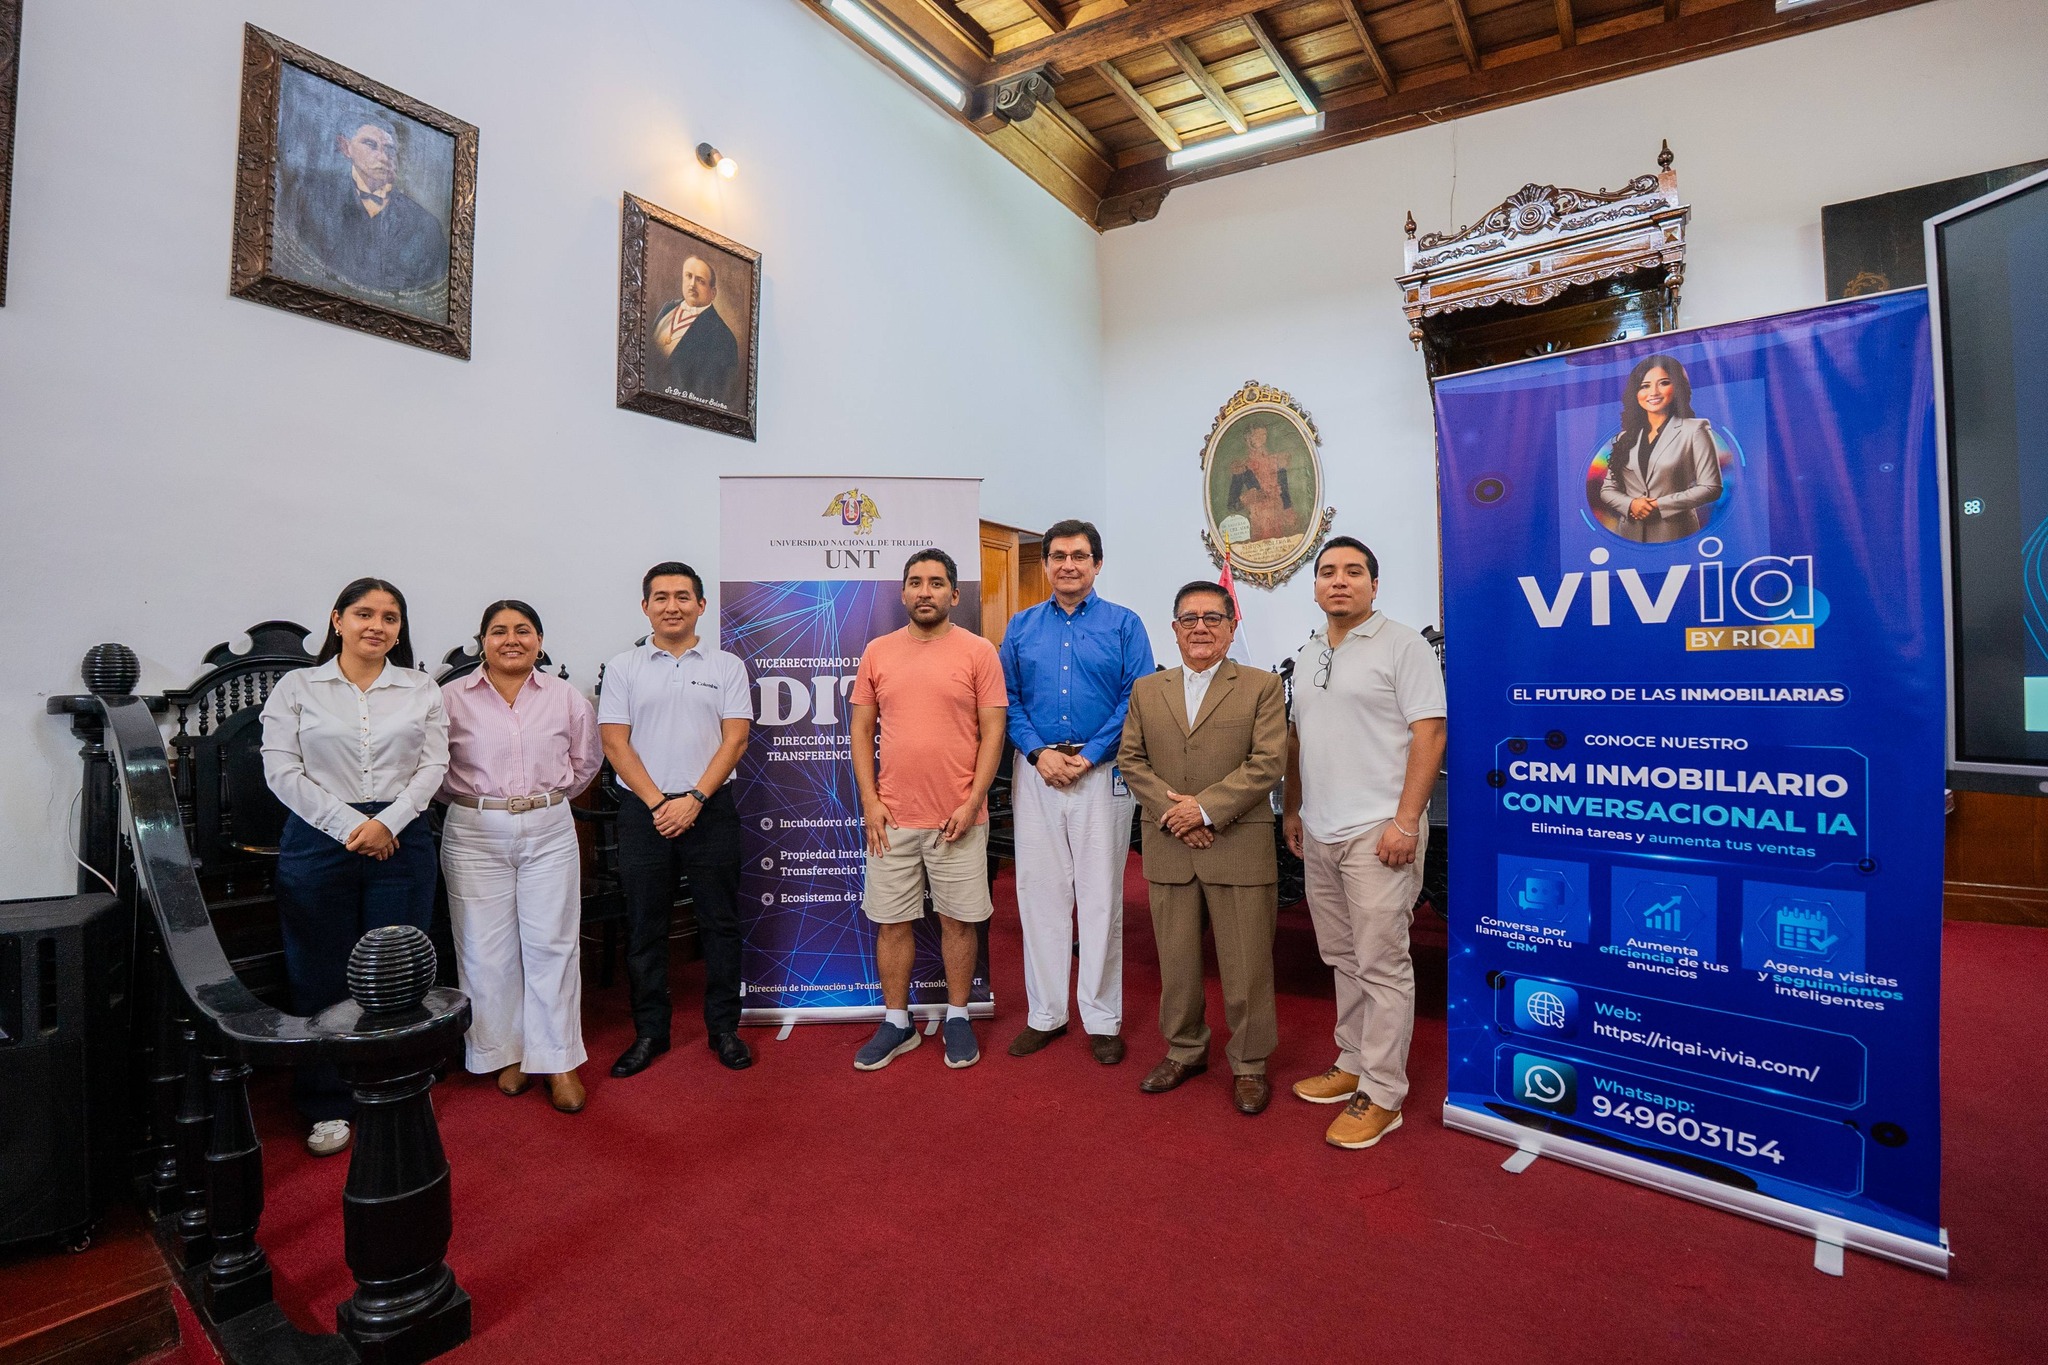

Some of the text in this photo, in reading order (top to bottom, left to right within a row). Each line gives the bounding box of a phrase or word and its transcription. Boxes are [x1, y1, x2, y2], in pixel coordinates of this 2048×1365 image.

[770, 539, 934, 547] UNIVERSIDAD NACIONAL DE TRUJILLO
[825, 550, 880, 569] UNT
[1517, 536, 1815, 629] vivia
[1690, 628, 1808, 649] BY RIQAI
[755, 657, 862, 669] VICERRECTORADO D
[1513, 687, 1845, 702] EL FUTURO DE LAS INMOBILIARIAS
[773, 733, 851, 746] DIRECCIÓN DE
[1584, 734, 1749, 751] CONOCE NUESTRO
[1509, 760, 1848, 798] CRM INMOBILIARIO
[779, 817, 843, 829] Incubadora
[844, 816, 858, 827] de
[1502, 791, 1858, 837] CONVERSACIONAL IA
[1531, 822, 1817, 858] Elimina tareas y aumenta tus ventas
[779, 848, 837, 862] Propiedad
[780, 865, 858, 877] Transferencia
[780, 892, 842, 903] Ecosistema
[843, 891, 857, 902] de
[1475, 924, 1573, 949] llamada con tu
[1480, 915, 1567, 937] Conversa por
[1506, 940, 1538, 954] CRM
[1626, 937, 1699, 957] Aumenta
[1599, 945, 1730, 974] eficiencia de tus
[1626, 960, 1698, 980] anuncios
[1763, 959, 1899, 988] Agenda visitas
[748, 984, 787, 992] Dirección
[789, 983, 799, 991] de
[801, 982, 846, 991] Innovación
[848, 983, 854, 992] y
[915, 980, 948, 988] Tecnoló
[1757, 971, 1904, 1001] y seguimientos
[1774, 983, 1886, 1012] inteligentes
[1594, 1001, 1642, 1022] Web:
[1592, 1021, 1821, 1083] https://riqai-vivia.com/
[1592, 1076, 1696, 1114] Whatsapp:
[1591, 1095, 1786, 1165] 949603154
